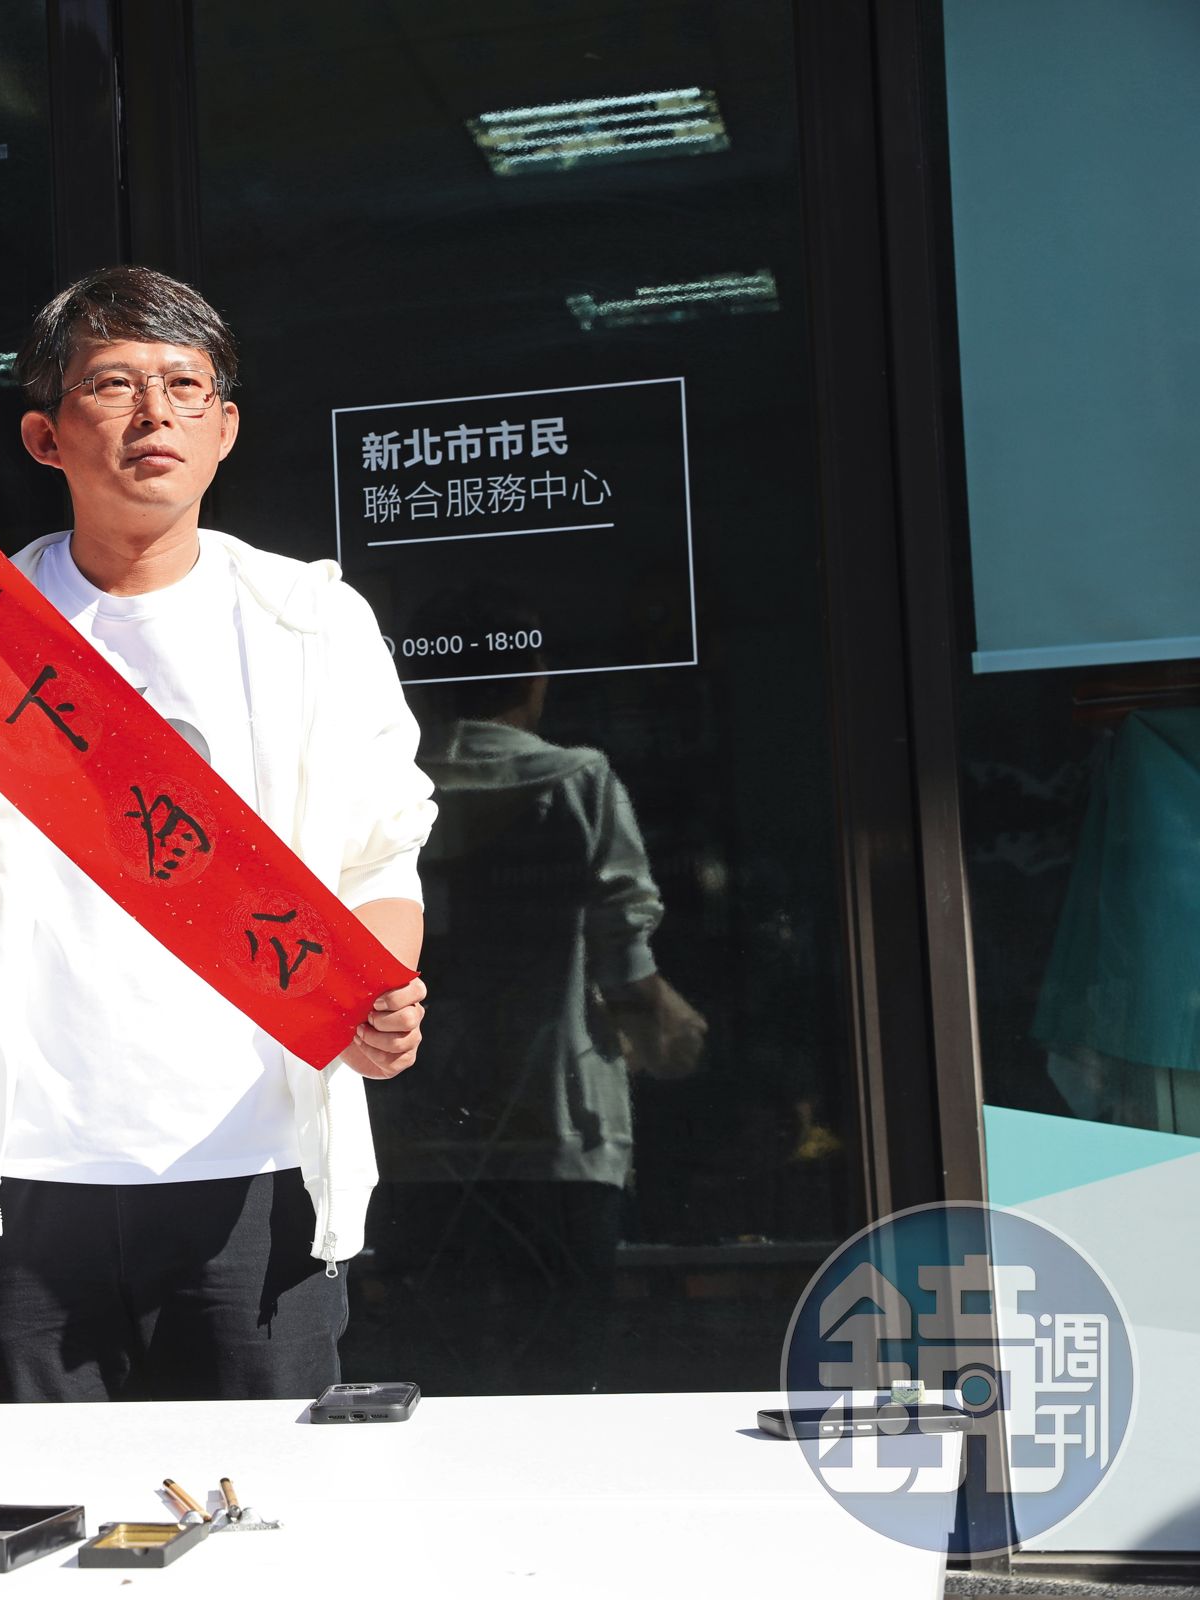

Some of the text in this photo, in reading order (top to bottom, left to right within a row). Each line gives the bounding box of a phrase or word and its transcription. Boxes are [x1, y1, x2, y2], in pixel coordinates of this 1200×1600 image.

[361, 417, 569, 472] 新北市市民
[363, 468, 612, 524] 聯合服務中心
[402, 634, 464, 658] 09:00
[485, 629, 543, 652] 18:00
